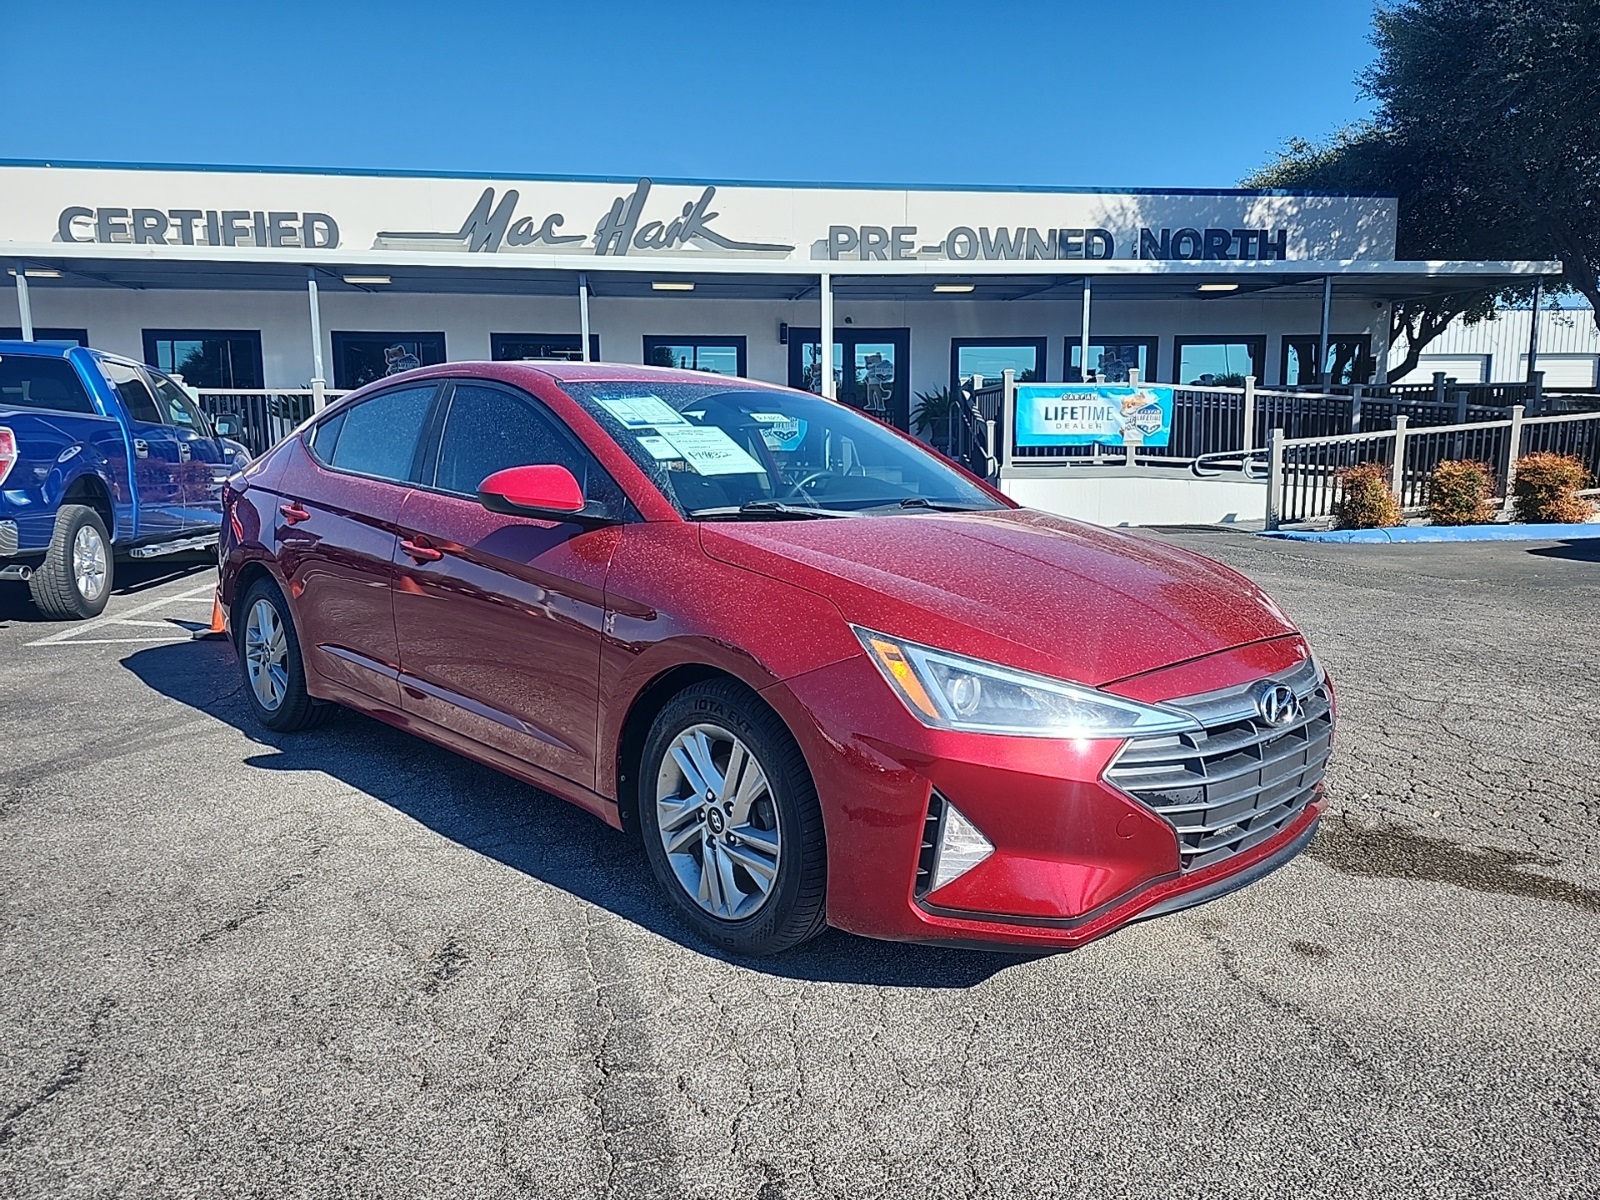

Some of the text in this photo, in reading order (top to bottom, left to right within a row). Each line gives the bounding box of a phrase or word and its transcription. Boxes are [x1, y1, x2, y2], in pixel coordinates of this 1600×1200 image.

[58, 206, 340, 249] CERTIFIED
[377, 177, 795, 256] Mac Haik
[828, 226, 1287, 260] PRE-OWNED NORTH
[1044, 406, 1114, 421] LIFETIME
[694, 699, 753, 733] IOTA EVT
